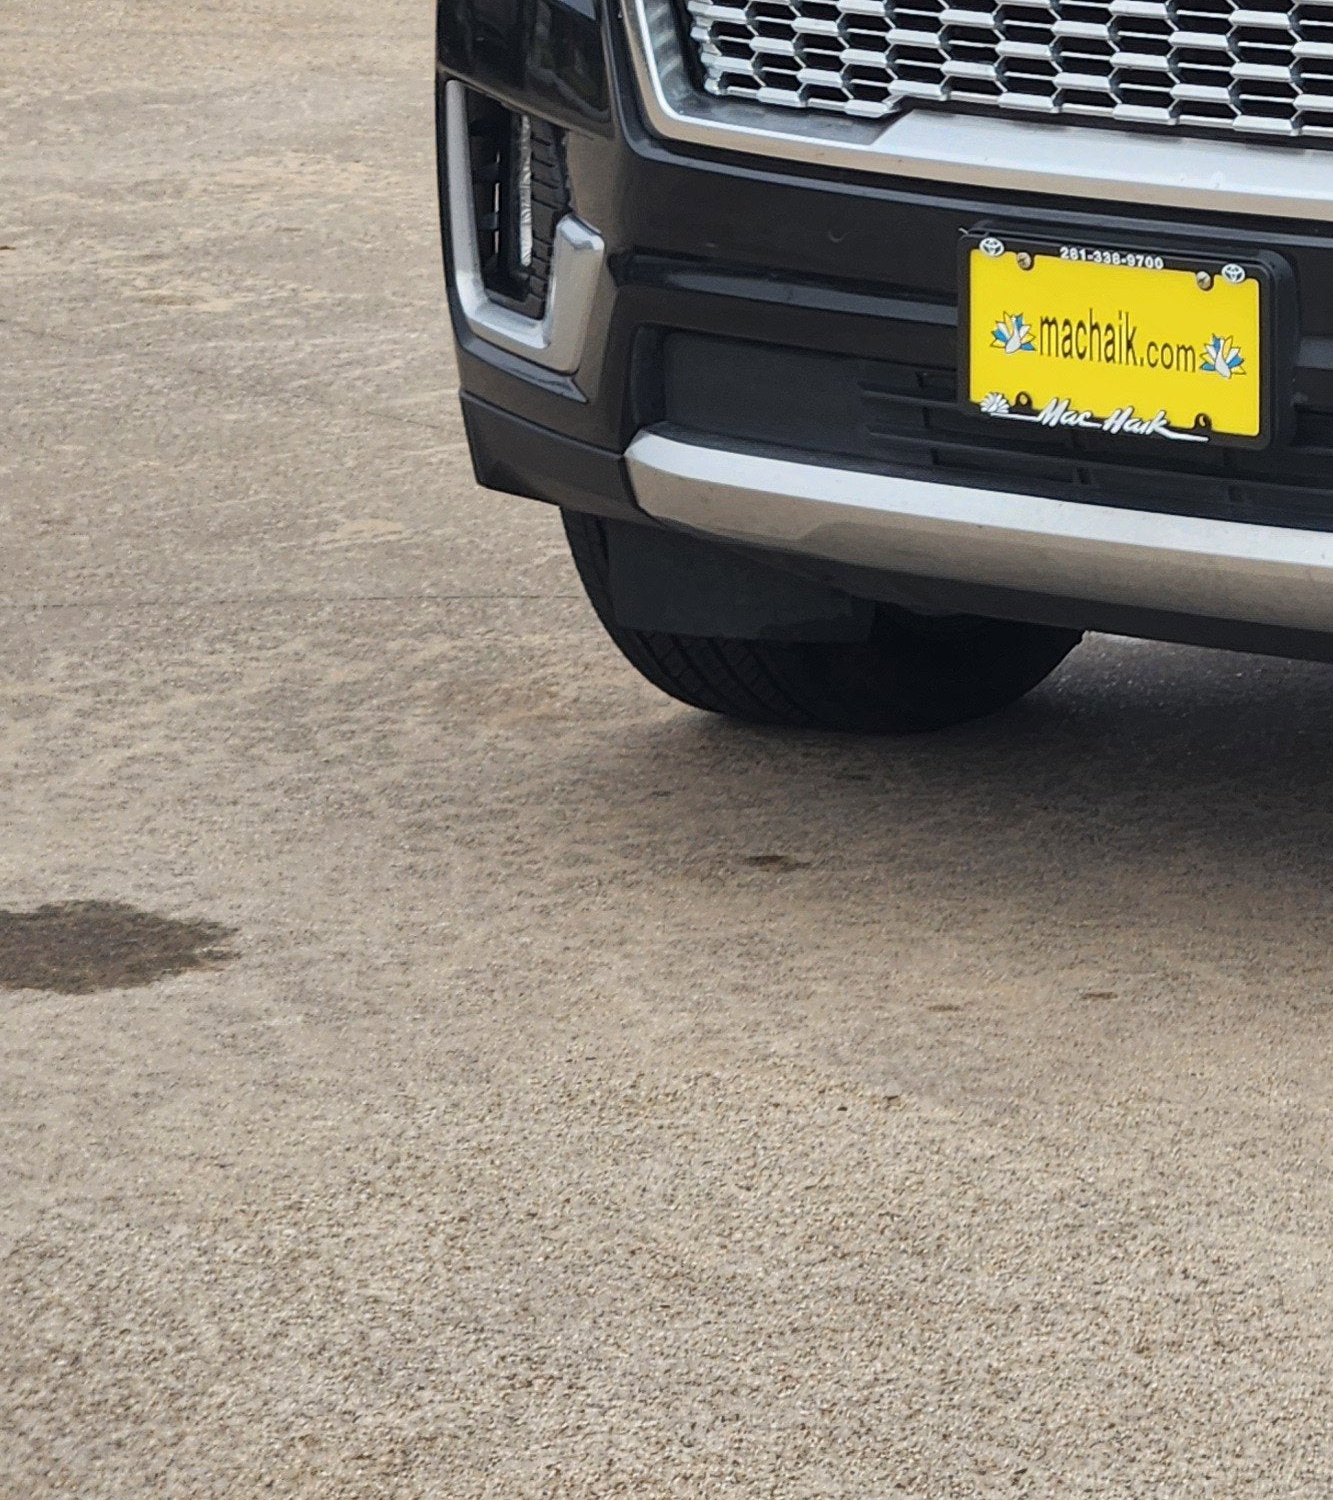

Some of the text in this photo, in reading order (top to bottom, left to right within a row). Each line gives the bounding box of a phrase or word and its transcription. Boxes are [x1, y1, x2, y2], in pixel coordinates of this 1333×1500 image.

[1059, 246, 1165, 270] 281-338-9700
[1039, 309, 1197, 373] machaik.com
[1039, 397, 1188, 437] Mac Haik
